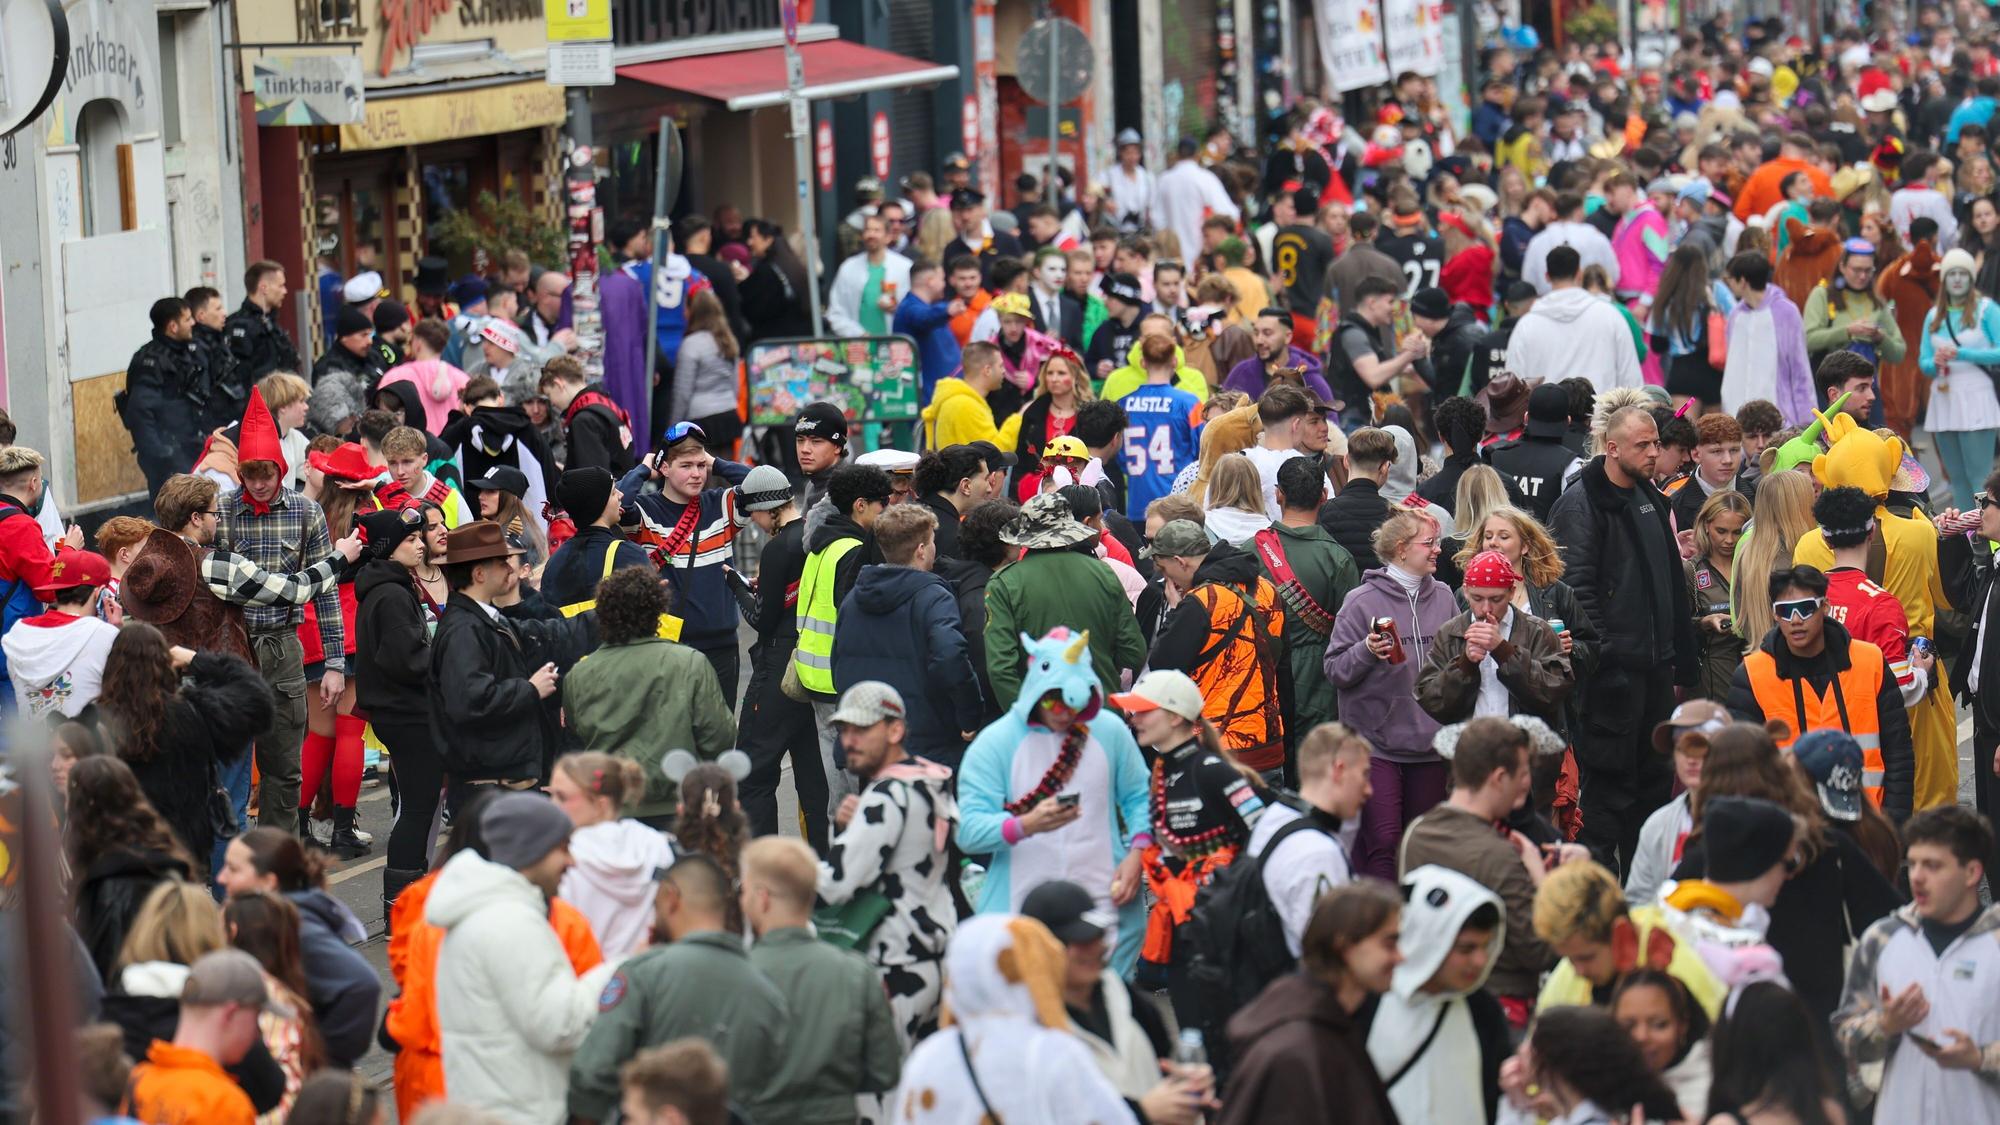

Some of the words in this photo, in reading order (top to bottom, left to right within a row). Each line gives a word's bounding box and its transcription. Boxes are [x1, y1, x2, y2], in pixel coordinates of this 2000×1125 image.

[264, 77, 344, 95] tinkhaar
[2, 134, 17, 171] 30
[1278, 246, 1297, 287] 8
[1402, 259, 1441, 299] 27
[1125, 396, 1173, 413] CASTLE
[1123, 424, 1175, 476] 54
[1513, 475, 1544, 497] AT
